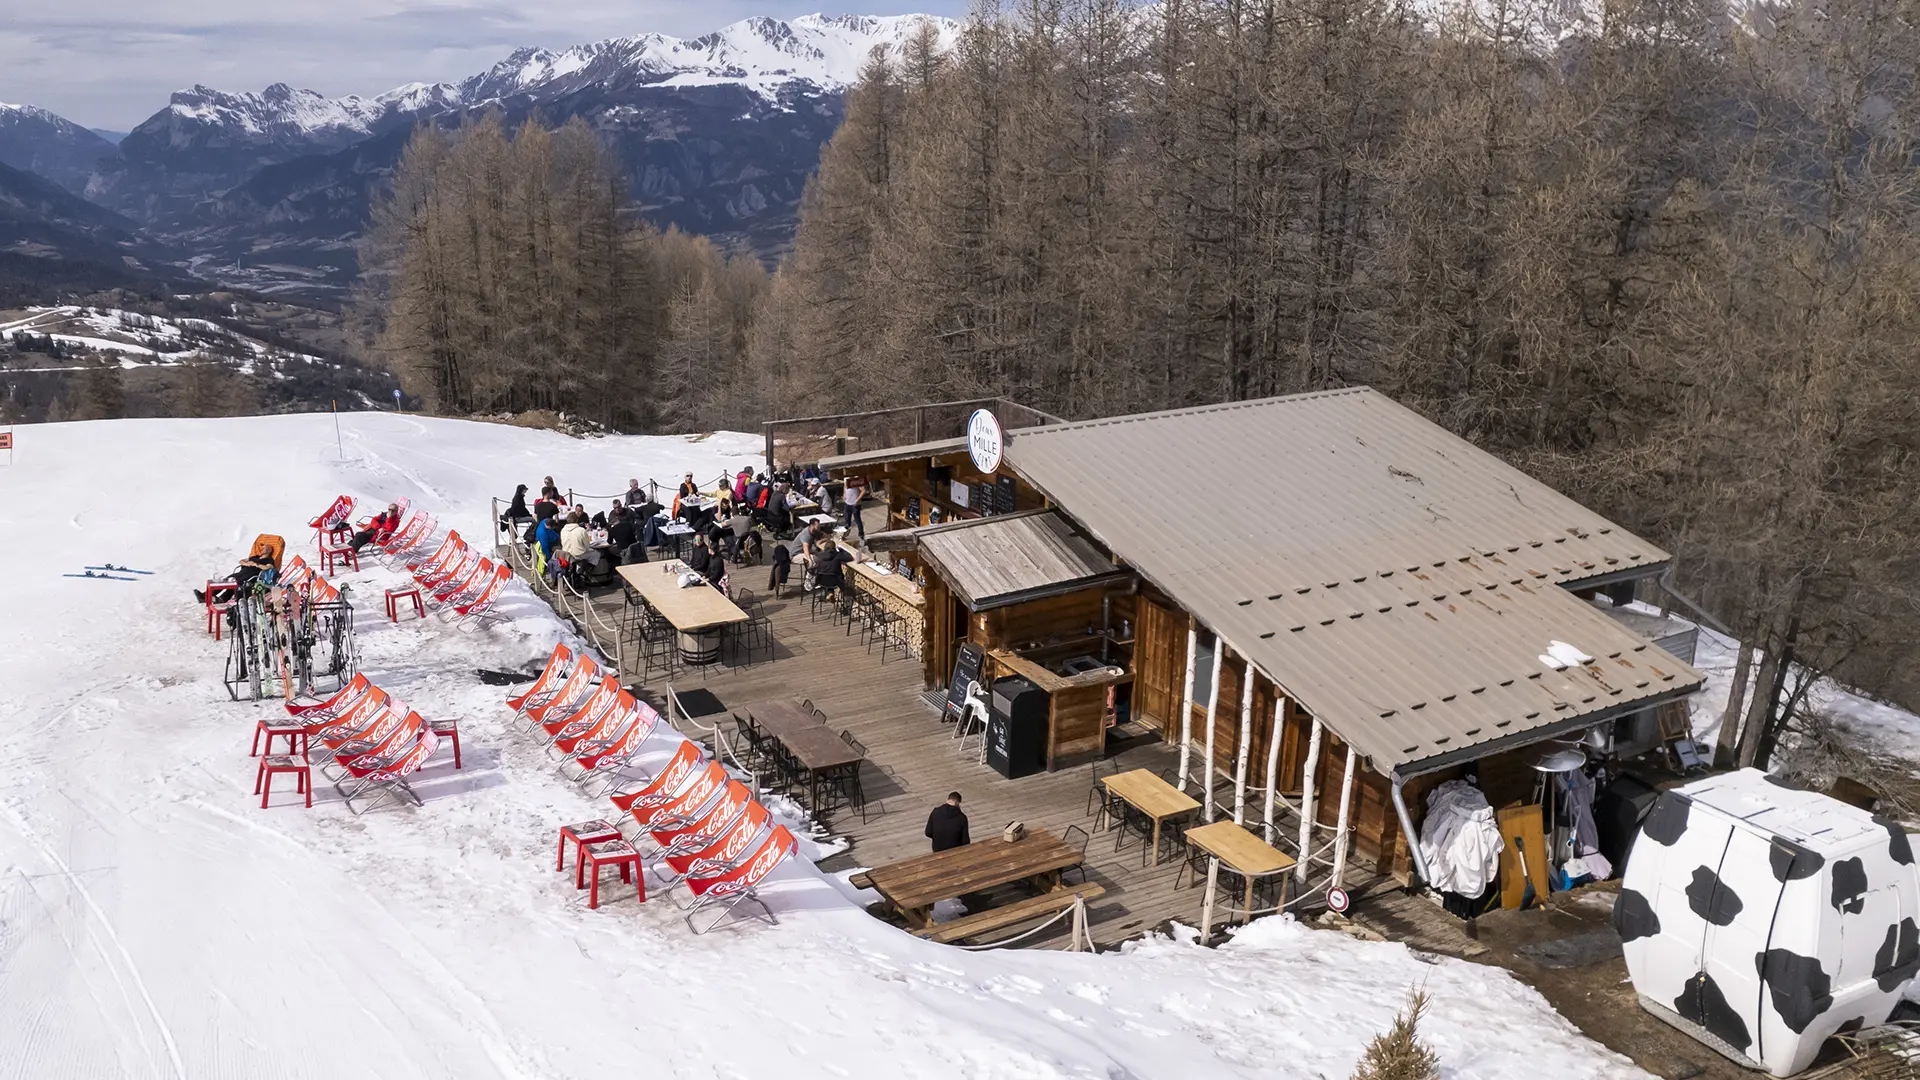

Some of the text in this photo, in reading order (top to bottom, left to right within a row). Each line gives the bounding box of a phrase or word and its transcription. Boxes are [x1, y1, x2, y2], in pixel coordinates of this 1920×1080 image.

[973, 435, 997, 456] MILLE
[324, 694, 377, 736] oca-Cola
[346, 712, 399, 749] oa-Cola
[564, 682, 612, 734] oca-Cola
[358, 721, 411, 764] oca-Cola
[631, 751, 689, 808] Coca-Cola
[649, 769, 713, 823] Coca-Cola
[688, 812, 756, 873] Coca-Cola
[706, 836, 781, 896] Coca-Cola
